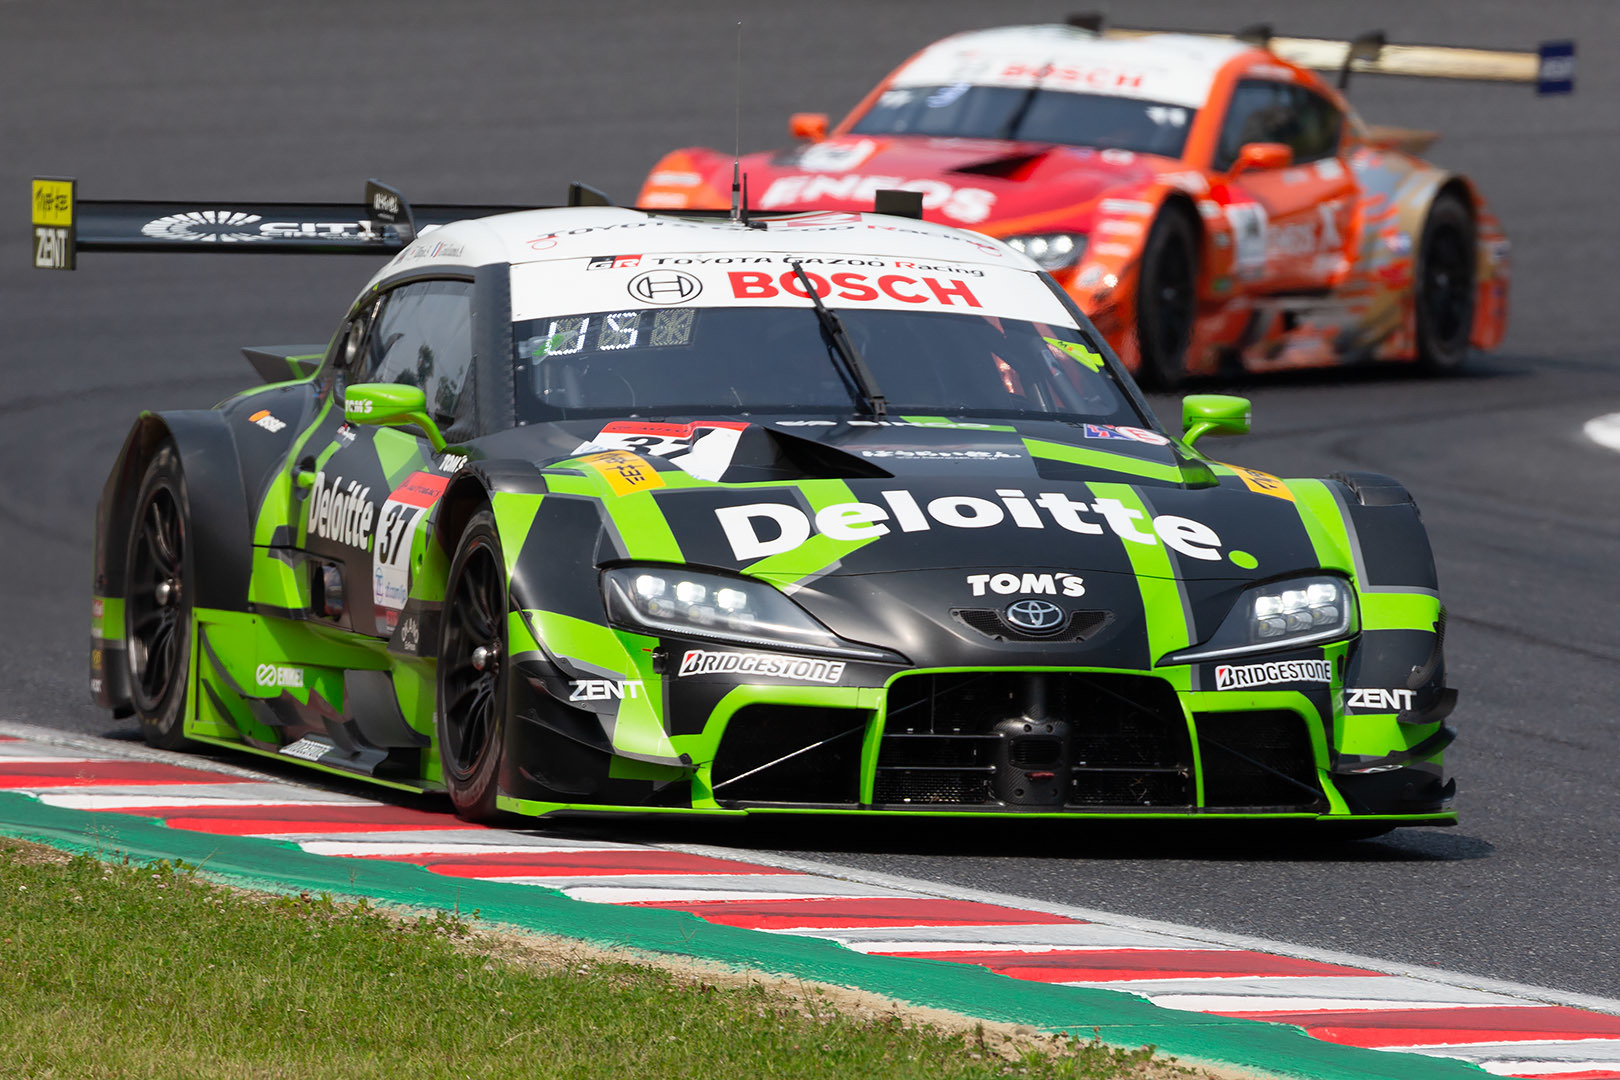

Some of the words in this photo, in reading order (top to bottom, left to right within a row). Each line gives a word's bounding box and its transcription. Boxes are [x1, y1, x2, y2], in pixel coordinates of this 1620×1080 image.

[35, 227, 68, 268] ZENT
[587, 254, 643, 271] GR
[652, 256, 772, 265] TOYOTA
[783, 256, 885, 268] GAZOO
[895, 260, 985, 277] Racing
[727, 271, 983, 308] BOSCH
[379, 504, 419, 566] 37
[966, 571, 1087, 598] TOM'S
[680, 651, 845, 683] BRIDGESTONE
[1217, 660, 1332, 690] BRIDGESTONE
[568, 679, 644, 702] ZENT
[1346, 688, 1418, 711] ZENT
